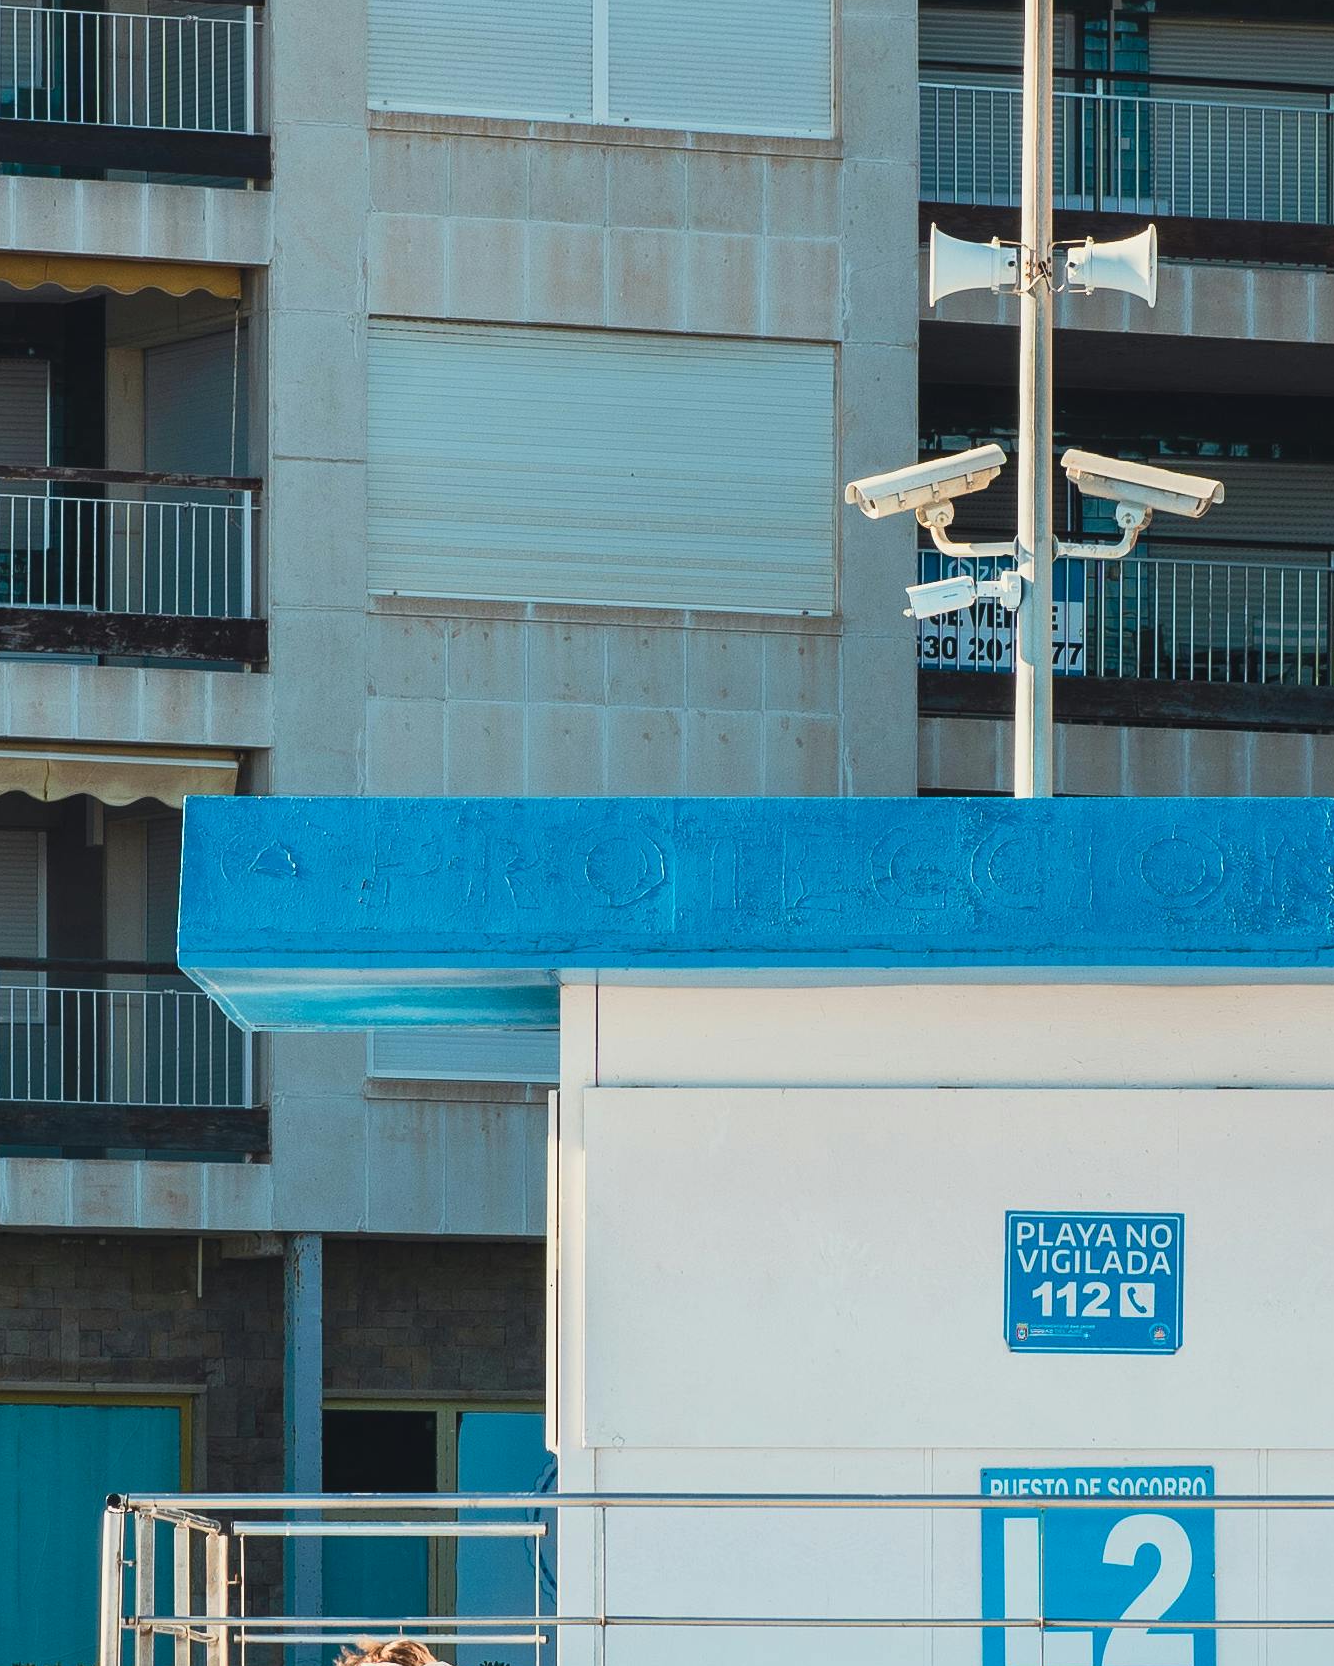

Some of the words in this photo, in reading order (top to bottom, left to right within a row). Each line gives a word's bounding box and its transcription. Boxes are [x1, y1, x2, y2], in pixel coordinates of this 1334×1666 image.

[917, 635, 957, 659] 30
[1016, 1222, 1117, 1247] PLAYA
[1126, 1223, 1173, 1249] NO
[1017, 1249, 1172, 1276] VIGILADA
[1032, 1281, 1111, 1318] 112
[990, 1478, 1068, 1496] PUESTO
[1075, 1478, 1101, 1496] DE
[1107, 1477, 1207, 1496] SOCORRO
